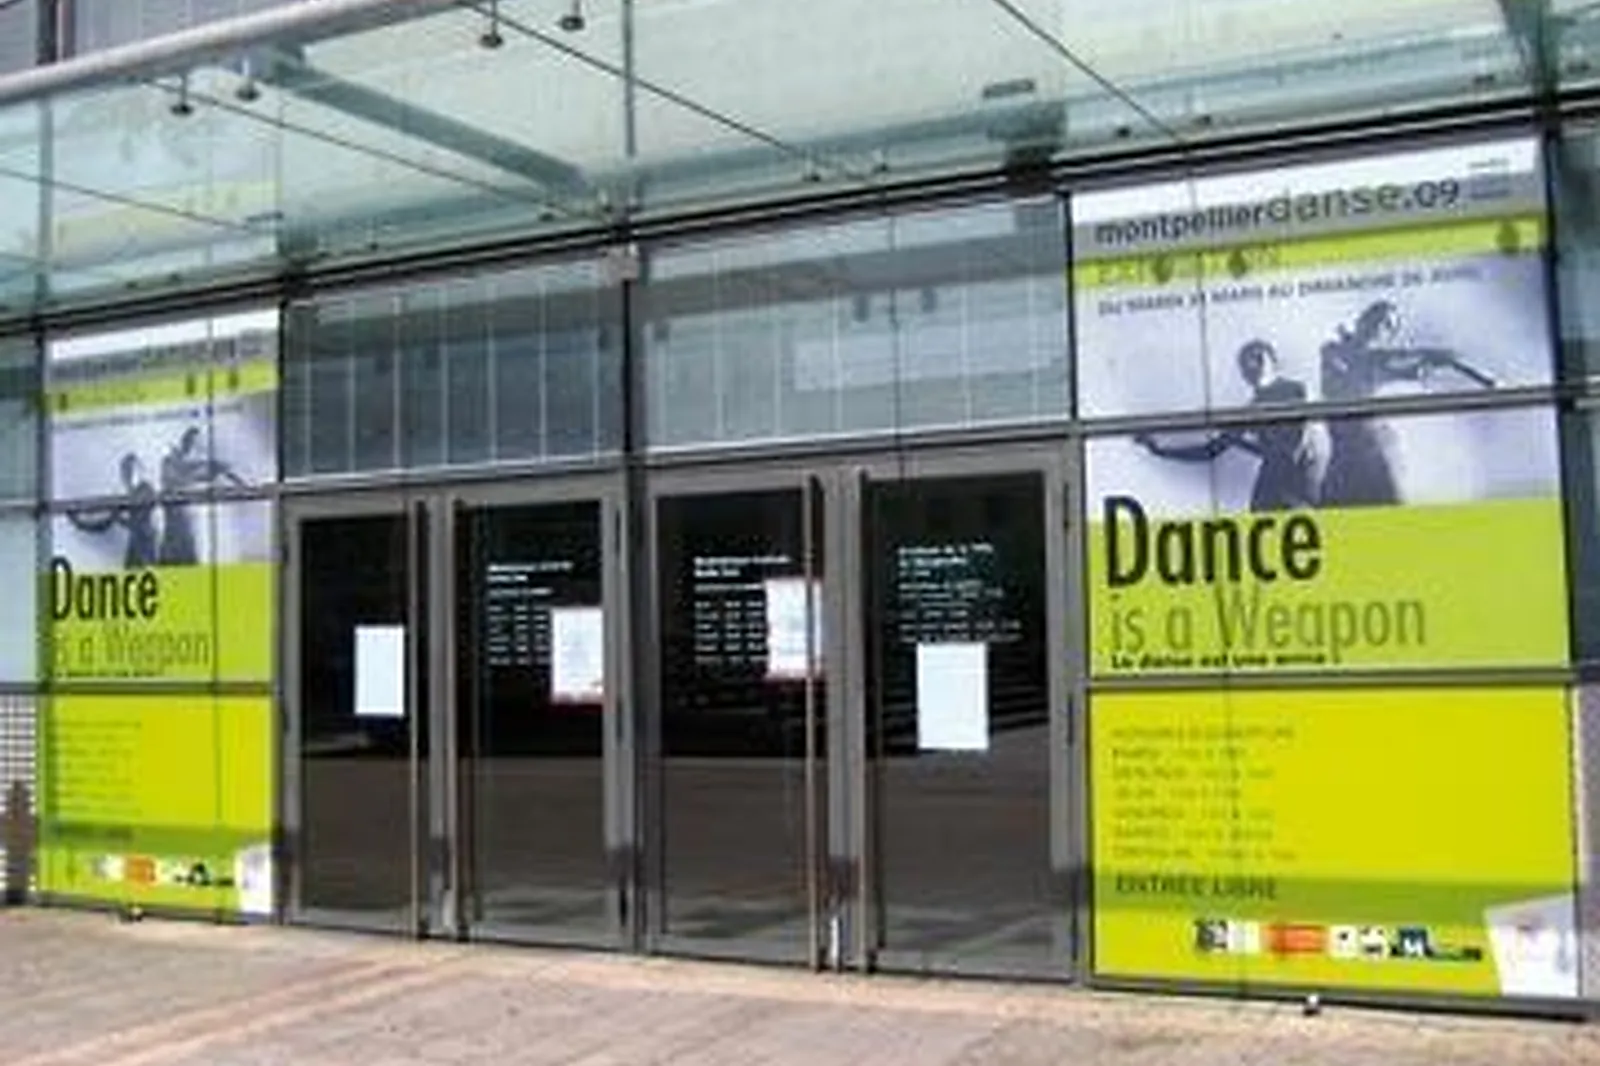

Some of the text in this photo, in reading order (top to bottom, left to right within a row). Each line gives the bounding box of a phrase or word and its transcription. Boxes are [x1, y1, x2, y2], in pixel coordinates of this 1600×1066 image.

[1104, 495, 1321, 587] Dance
[50, 556, 159, 621] Dance
[1110, 581, 1427, 664] is a Weapon
